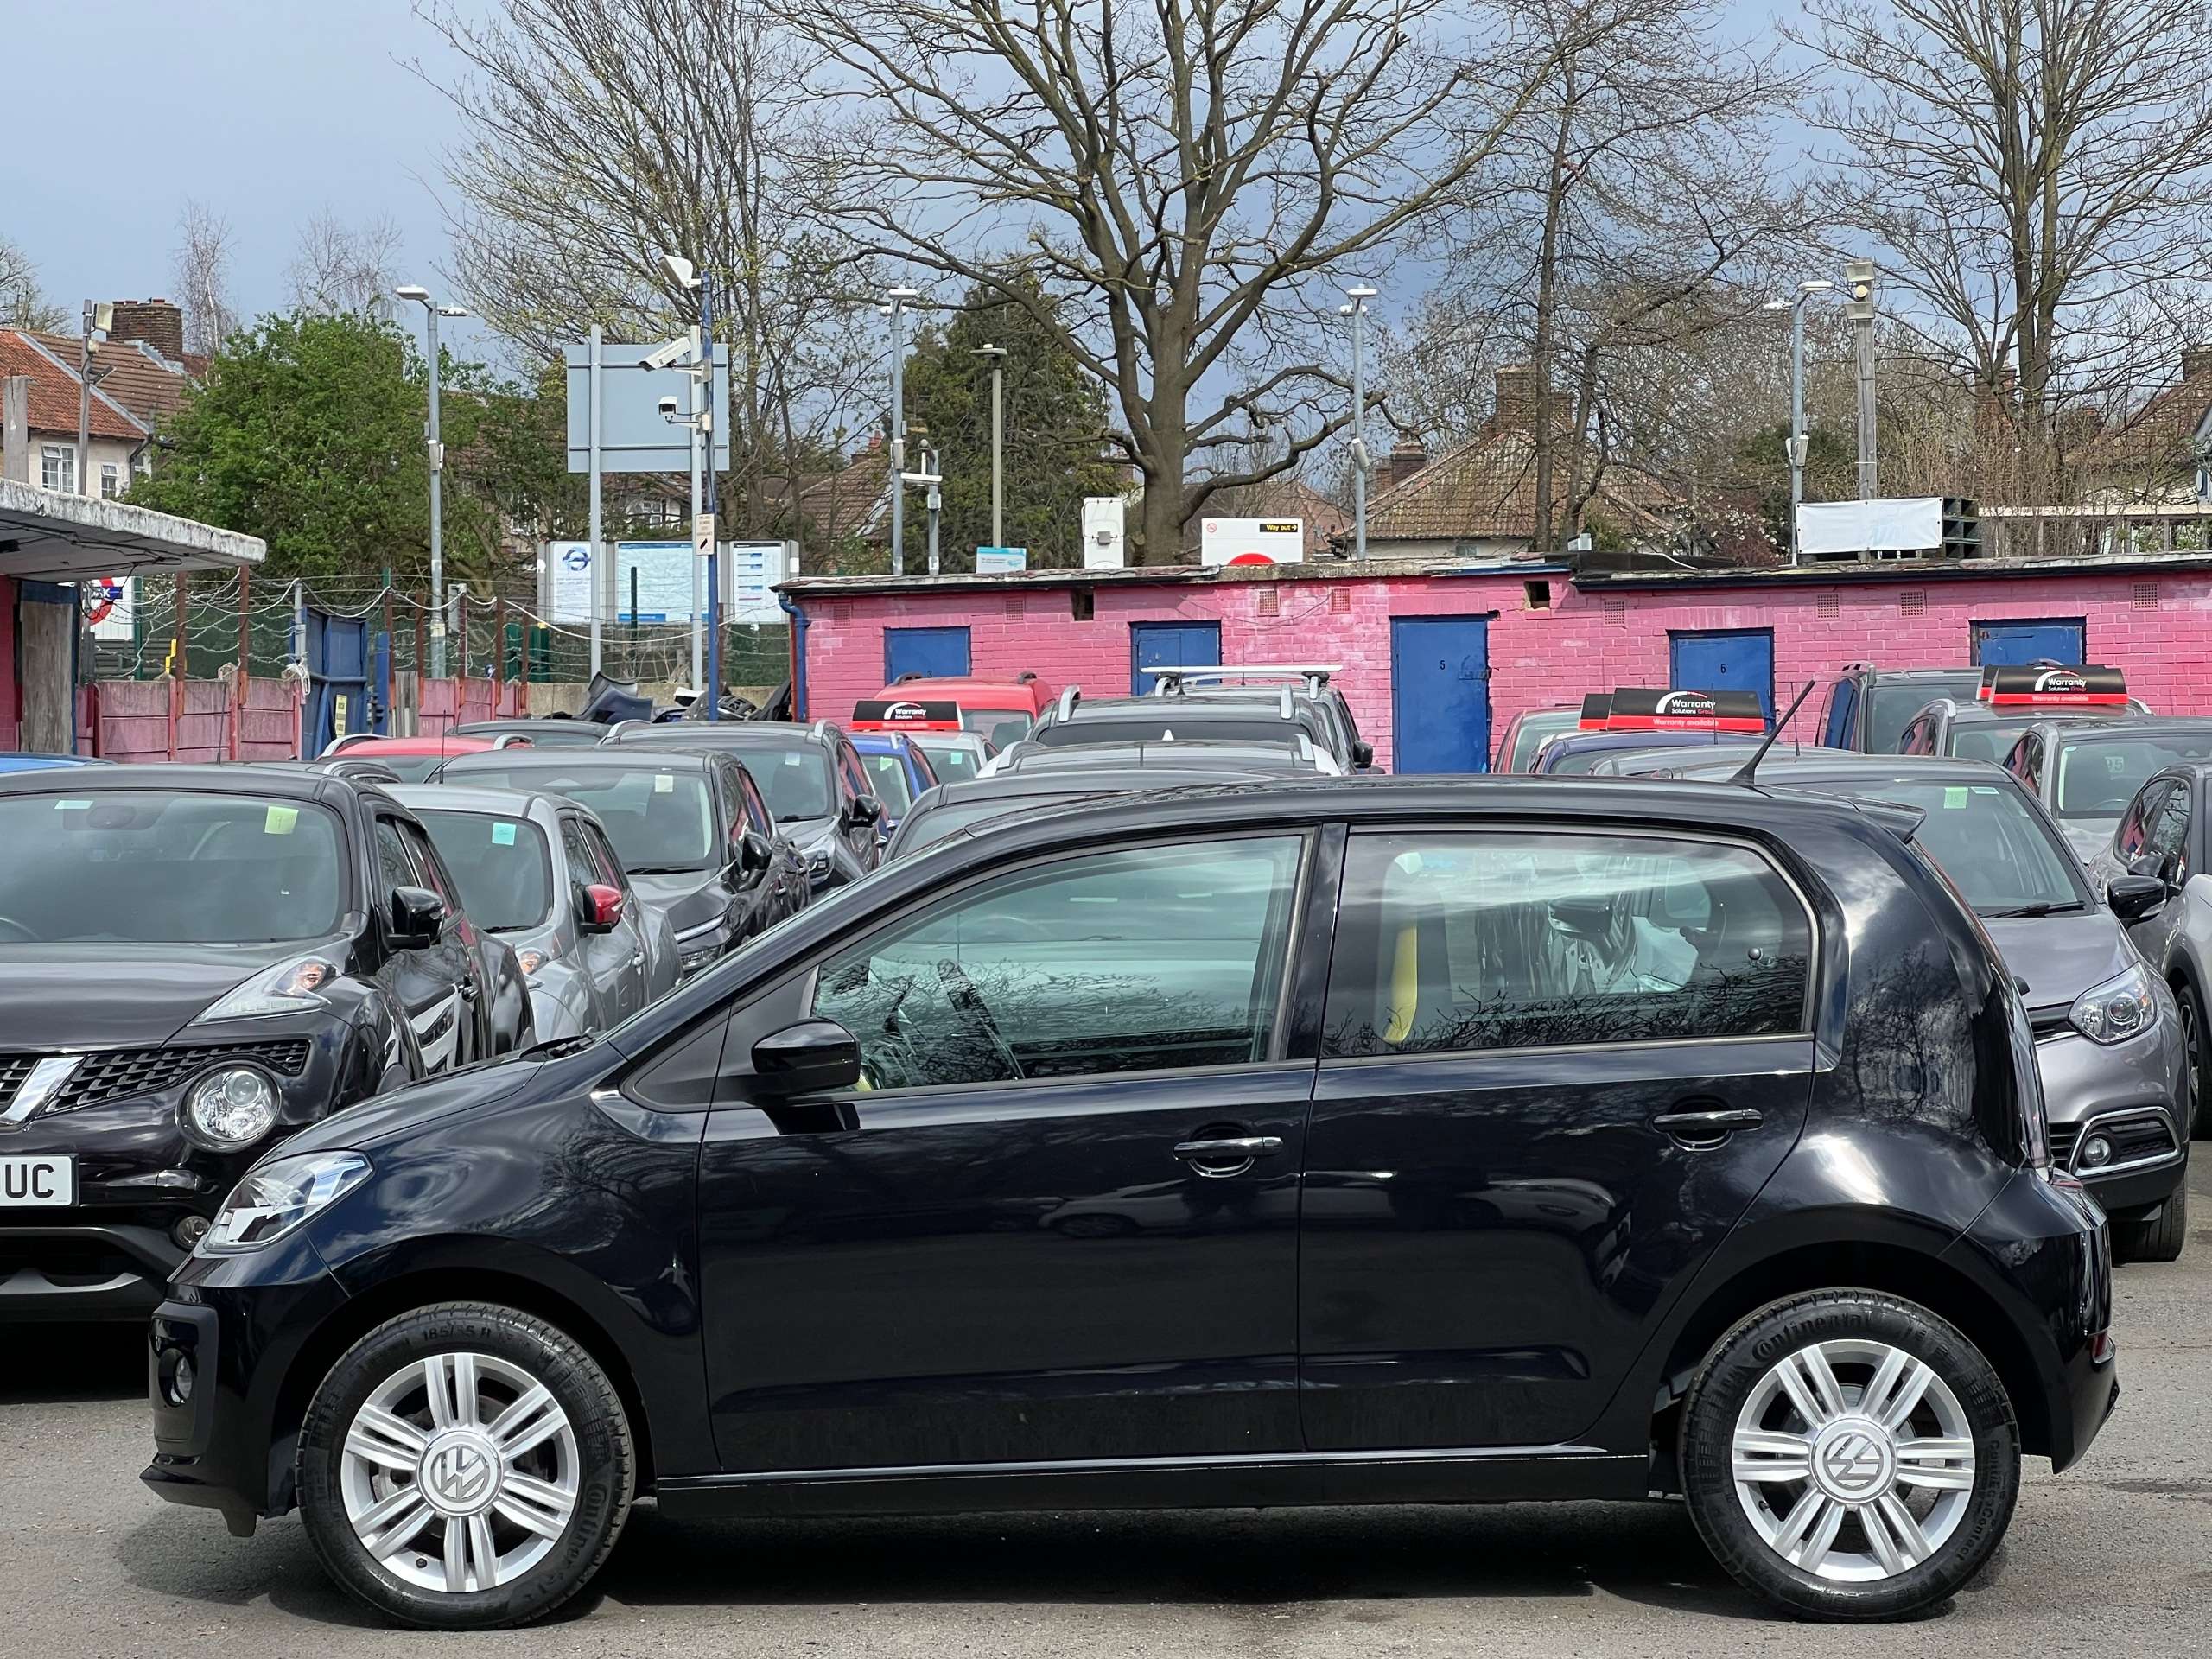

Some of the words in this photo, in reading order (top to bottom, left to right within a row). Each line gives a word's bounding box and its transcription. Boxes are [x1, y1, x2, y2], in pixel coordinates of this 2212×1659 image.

[1440, 659, 1446, 671] 5
[1720, 663, 1726, 674] 6
[2048, 678, 2087, 688] Warranty
[1671, 699, 1716, 710] Warranty
[895, 709, 926, 717] Warranty
